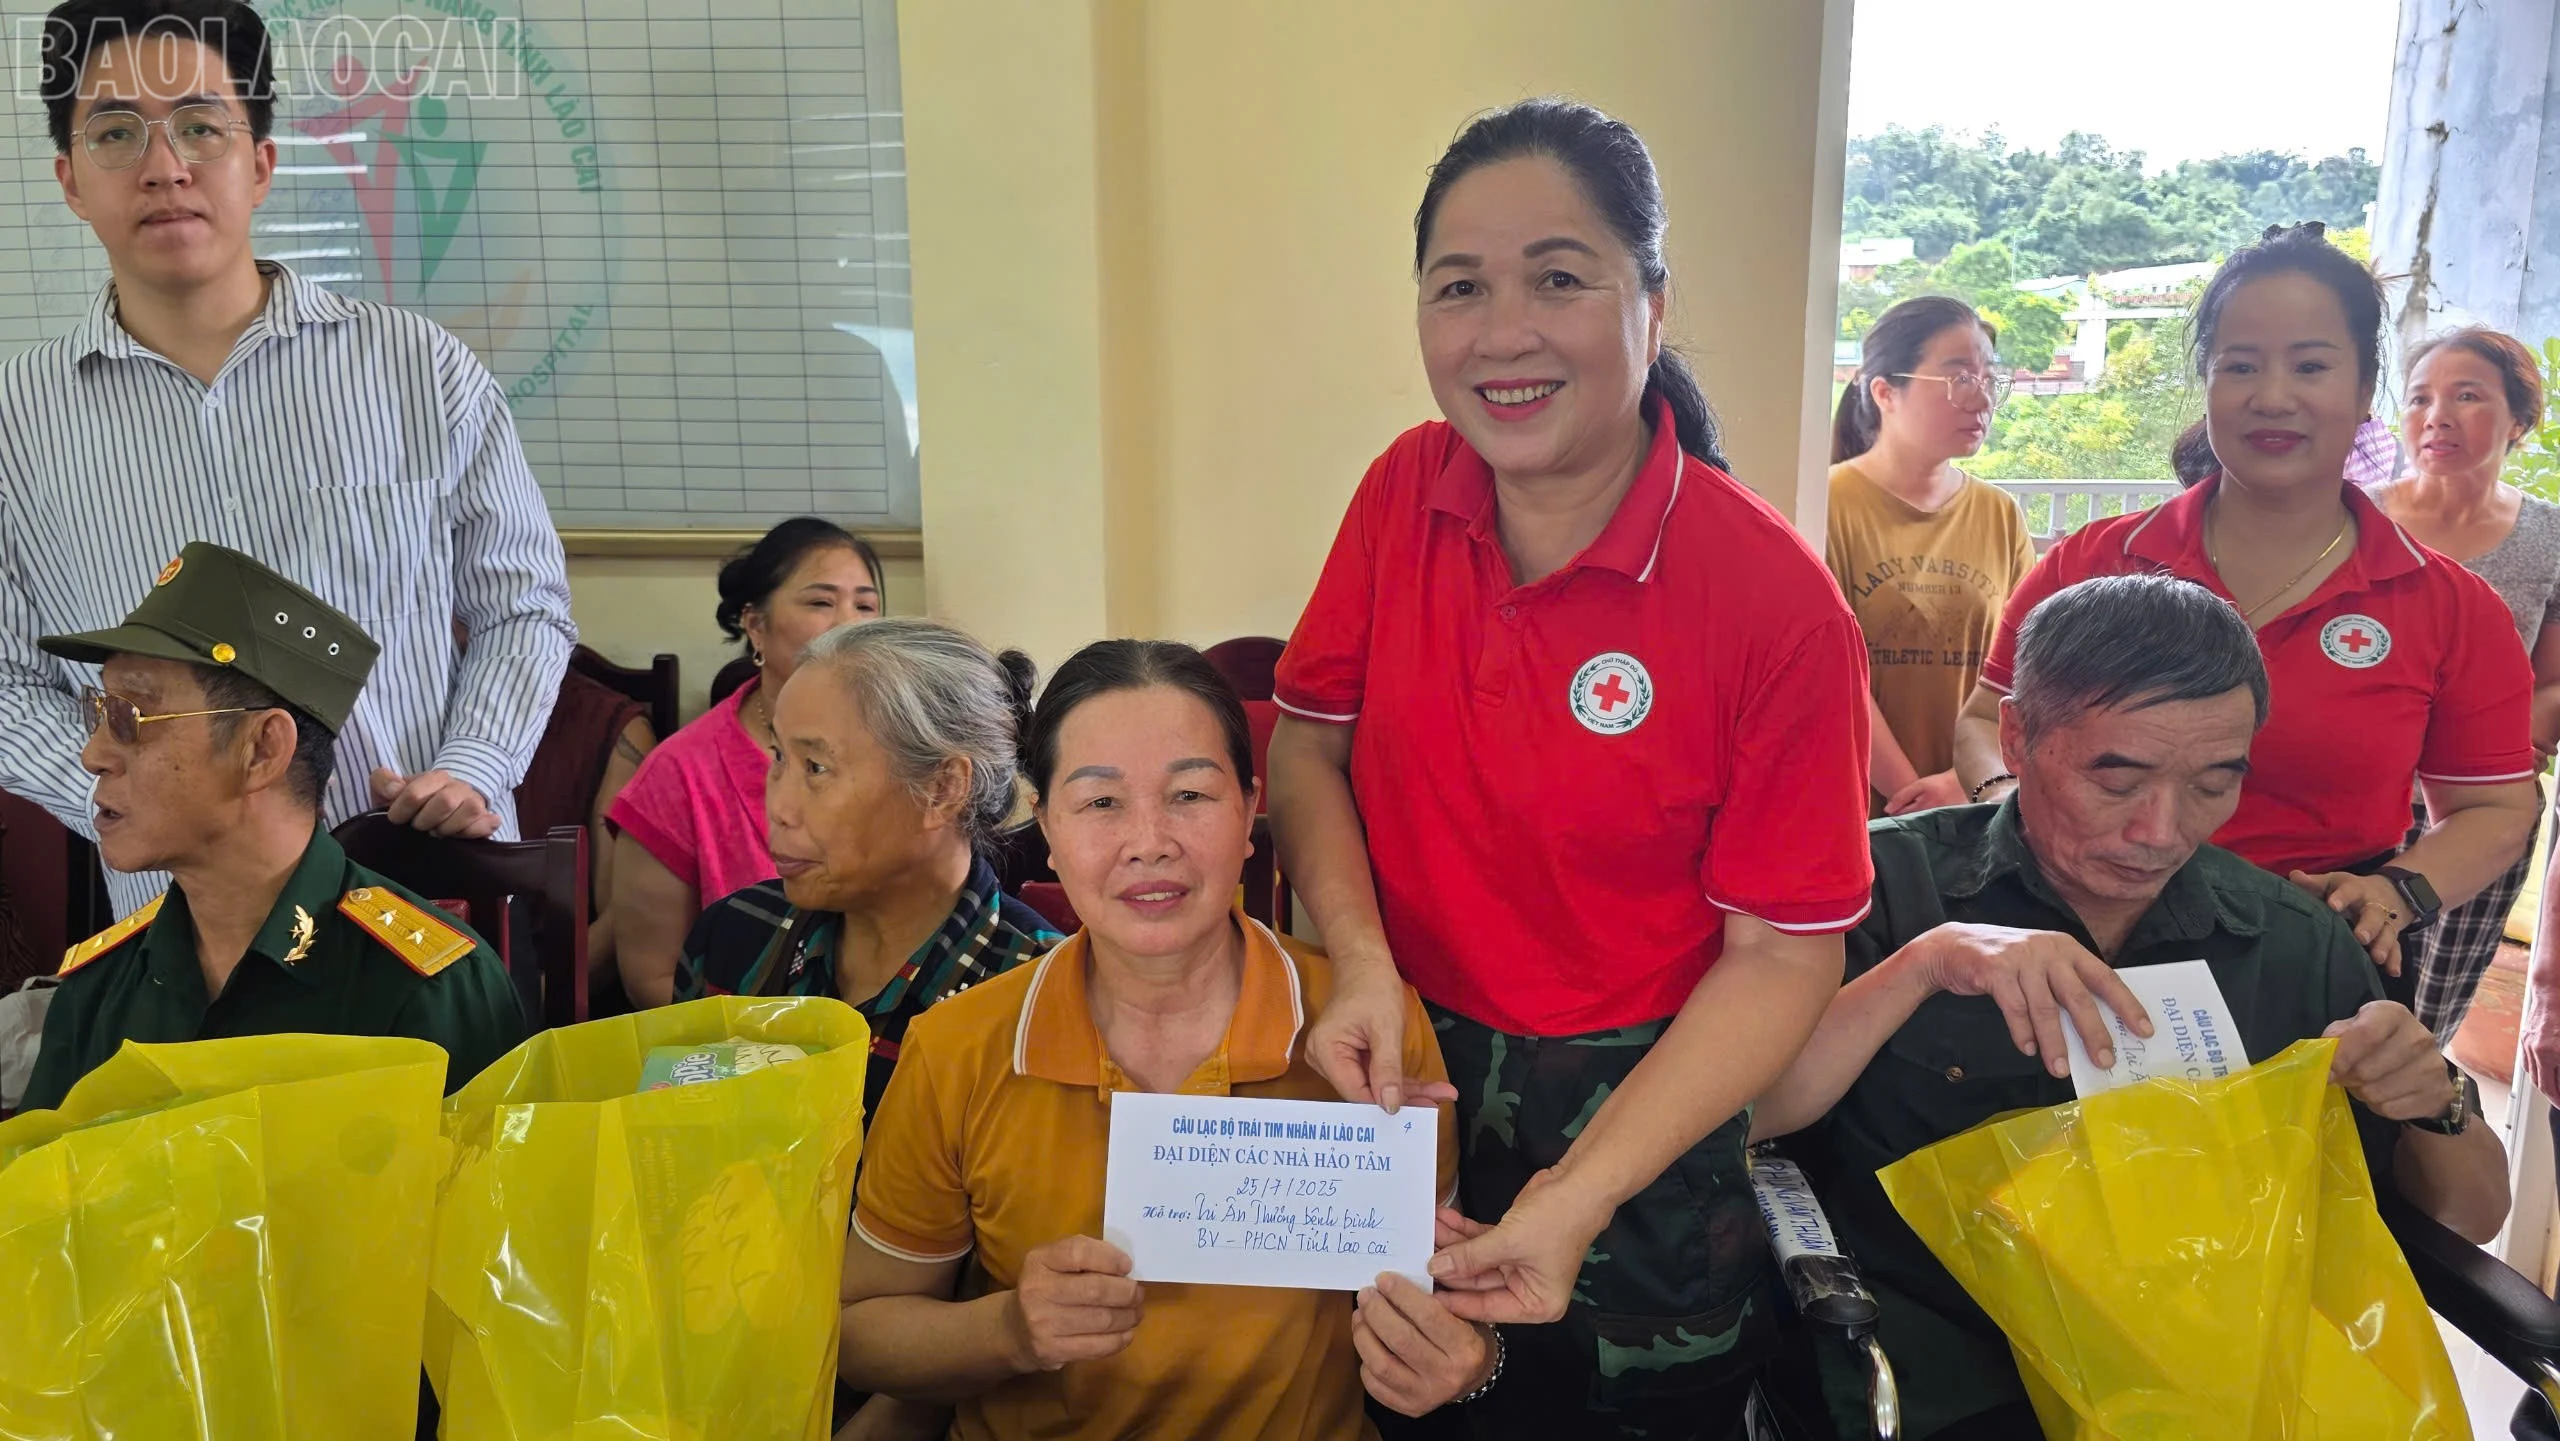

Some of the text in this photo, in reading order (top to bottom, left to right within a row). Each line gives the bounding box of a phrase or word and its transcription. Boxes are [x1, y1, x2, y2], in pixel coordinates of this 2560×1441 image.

[571, 145, 603, 194] CAI
[508, 303, 595, 410] HOSPITAL
[1852, 555, 2000, 599] LADY VARSITY
[1898, 582, 1946, 595] NUMBER
[1869, 648, 1934, 666] THLETIC
[2161, 997, 2184, 1022] ĐẠI
[2173, 1025, 2198, 1063] DIỆN
[2200, 1028, 2220, 1049] LẠC
[2206, 1049, 2228, 1064] BỘ
[2212, 1065, 2229, 1079] TR
[1172, 1115, 1375, 1143] CÂU LẠC BỘ TRÁI TIM NHÂN ÁI LÀO CAI
[1153, 1143, 1392, 1172] ĐẠI DIỆN CÁC NHÀ HẢO TÂM
[1142, 1204, 1165, 1219] Hỗ
[1168, 1208, 1191, 1223] trợ:
[1197, 1227, 1220, 1249] BV
[1244, 1230, 1289, 1251] PHCN
